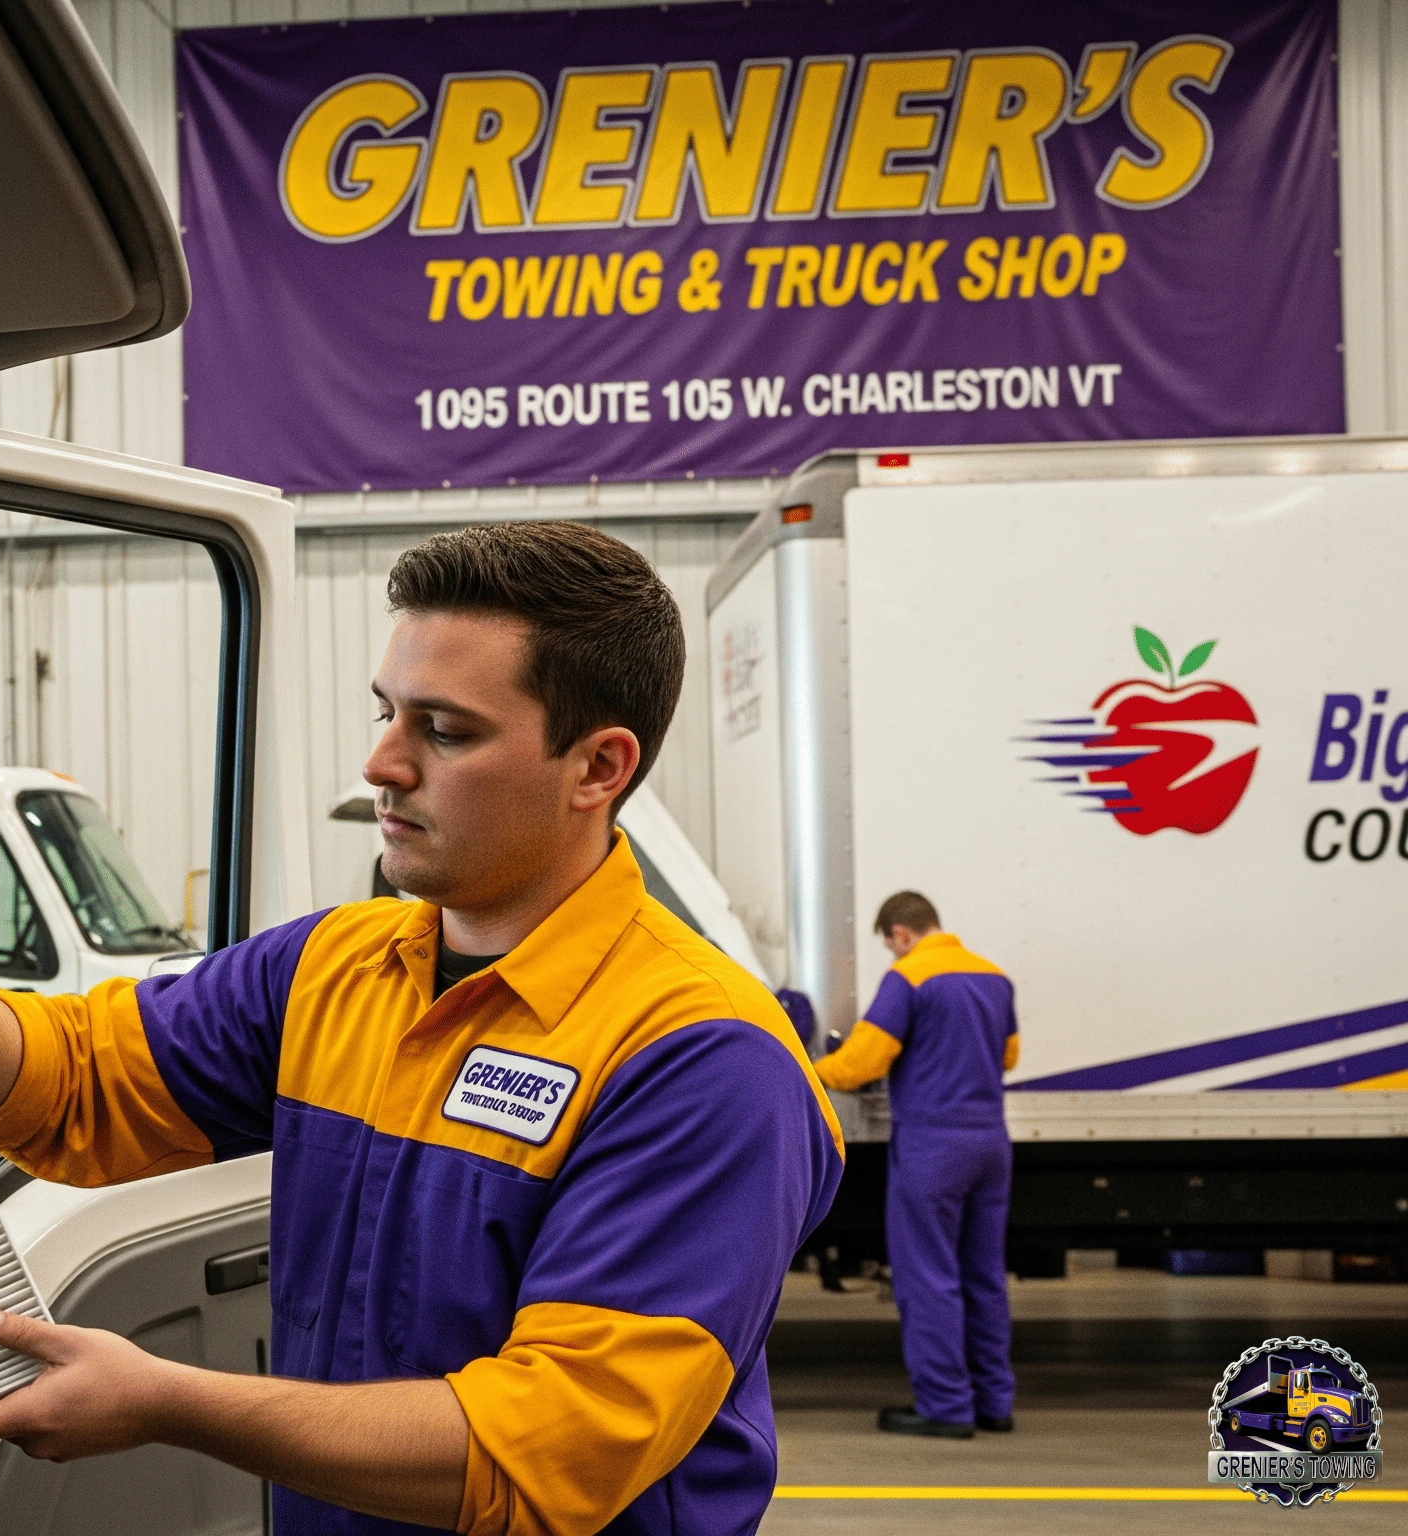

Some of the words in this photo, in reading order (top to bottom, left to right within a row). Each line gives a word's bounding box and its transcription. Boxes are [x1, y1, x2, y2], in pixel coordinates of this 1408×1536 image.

[278, 36, 1234, 243] GRENIER'S
[424, 249, 665, 322] TOWING
[677, 248, 723, 313] &
[745, 239, 948, 310] TRUCK
[958, 232, 1127, 302] SHOP
[414, 386, 509, 431] 1095
[517, 379, 652, 427] ROUTE
[661, 377, 734, 422] 105
[740, 375, 793, 419] W.
[802, 365, 1060, 418] CHARLESTON
[1067, 363, 1123, 407] VT
[1304, 807, 1408, 863] CO
[464, 1062, 565, 1104] GRENIER'S
